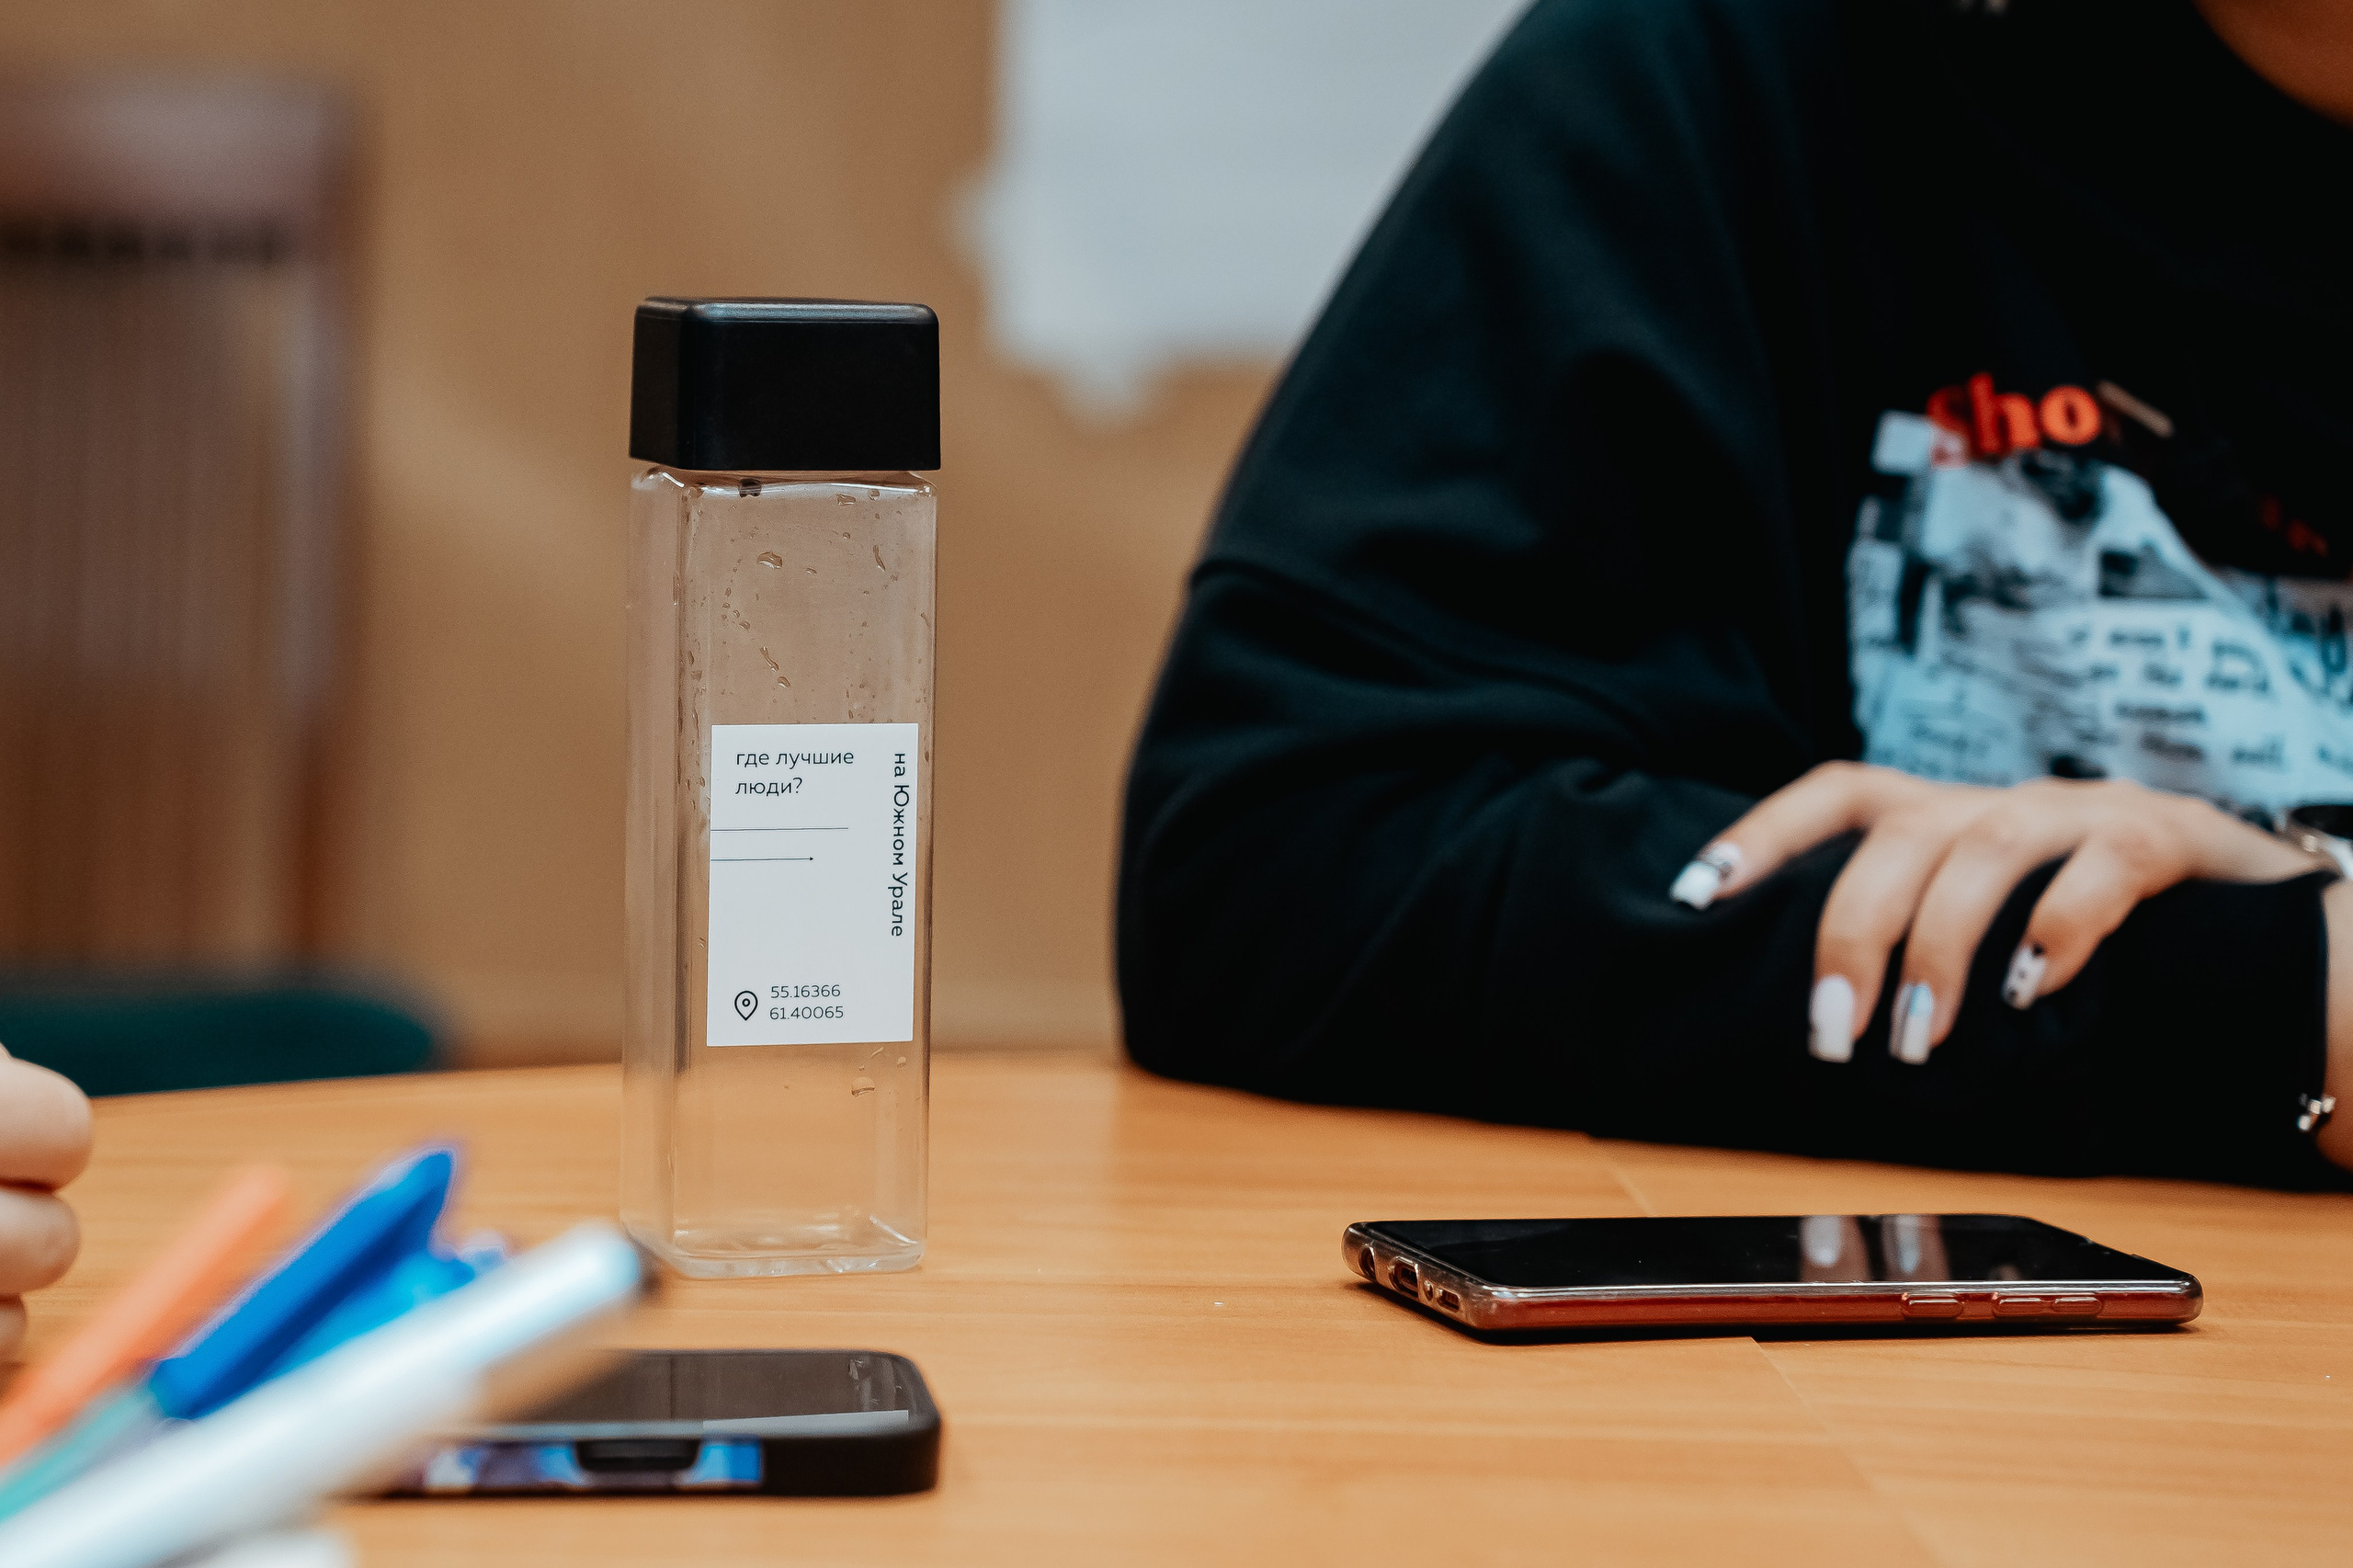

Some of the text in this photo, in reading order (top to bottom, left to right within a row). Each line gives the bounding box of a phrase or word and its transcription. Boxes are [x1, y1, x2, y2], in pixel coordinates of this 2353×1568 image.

[735, 752, 855, 770] где лучшие
[734, 777, 803, 797] люди?
[887, 752, 910, 937] на Южном Урале
[770, 983, 842, 999] 55.16366
[769, 1005, 845, 1021] 61.40065
